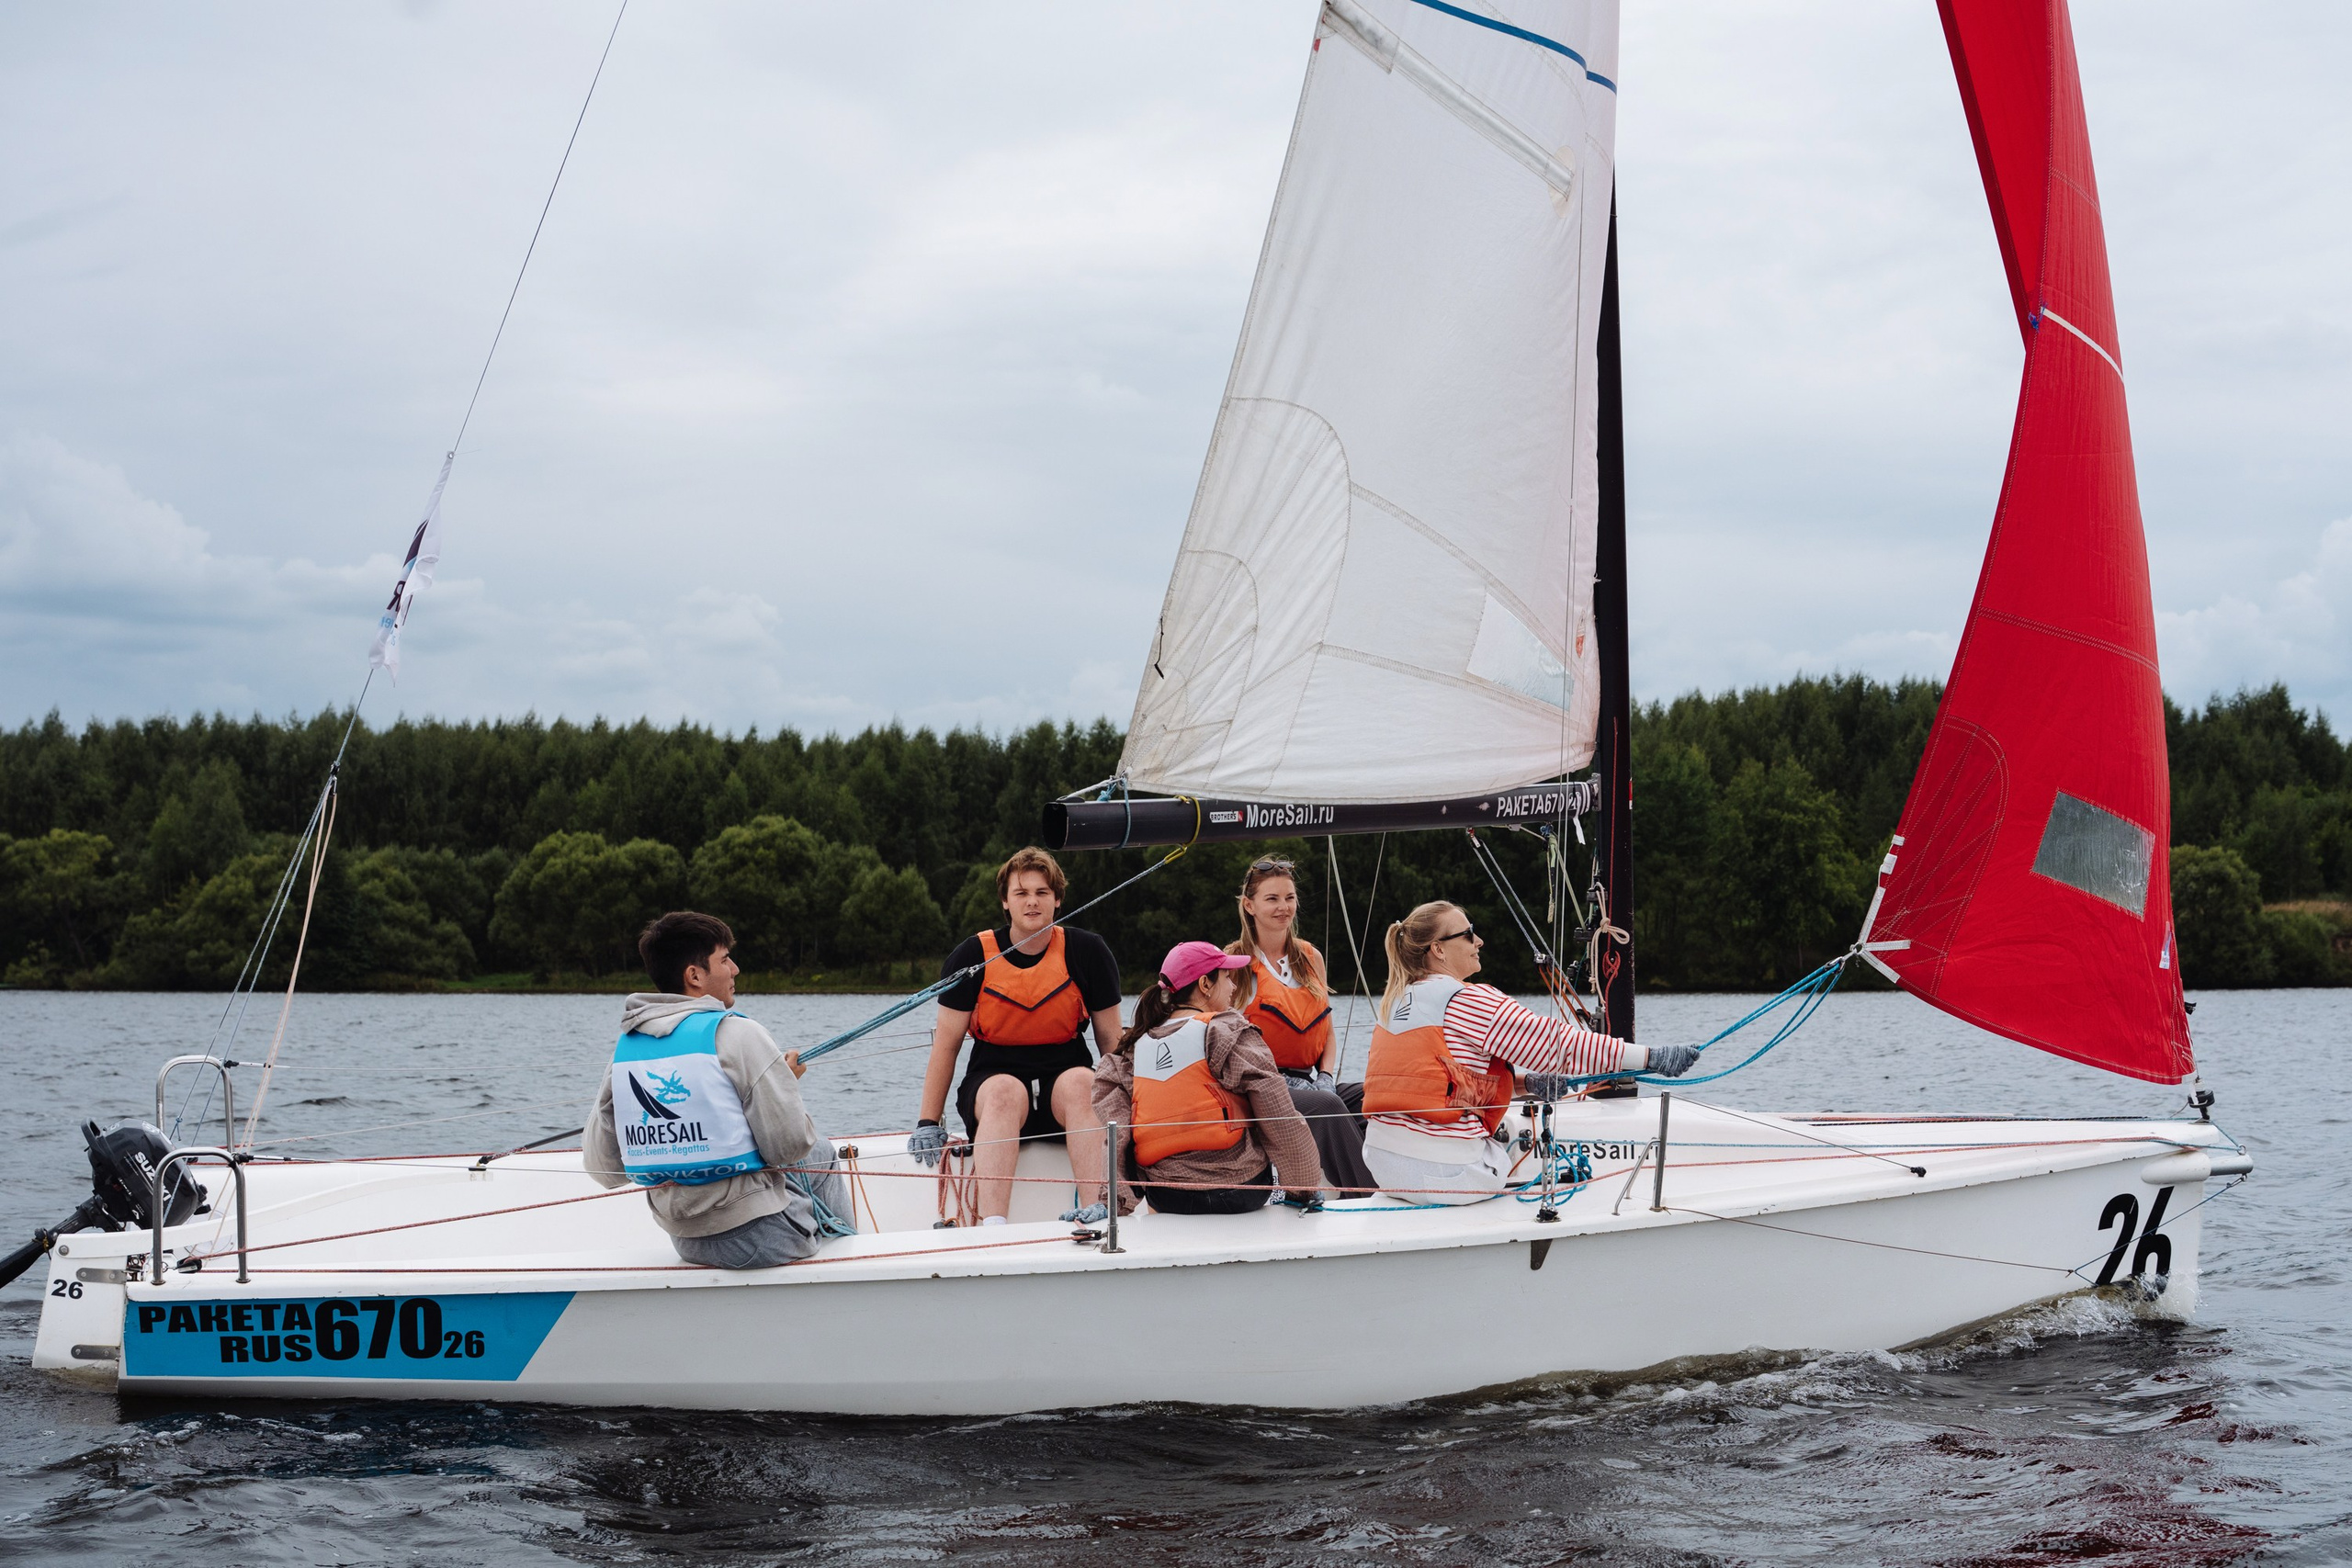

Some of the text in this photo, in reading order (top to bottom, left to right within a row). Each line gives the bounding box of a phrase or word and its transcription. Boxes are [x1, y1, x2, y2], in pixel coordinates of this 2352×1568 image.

[1210, 813, 1237, 821] BROTHERS
[1246, 804, 1334, 829] MoreSail.ru
[134, 1151, 172, 1201] SUZKI
[2095, 1185, 2175, 1297] 26
[51, 1279, 84, 1300] 26
[220, 1297, 485, 1363] RUS 670 26
